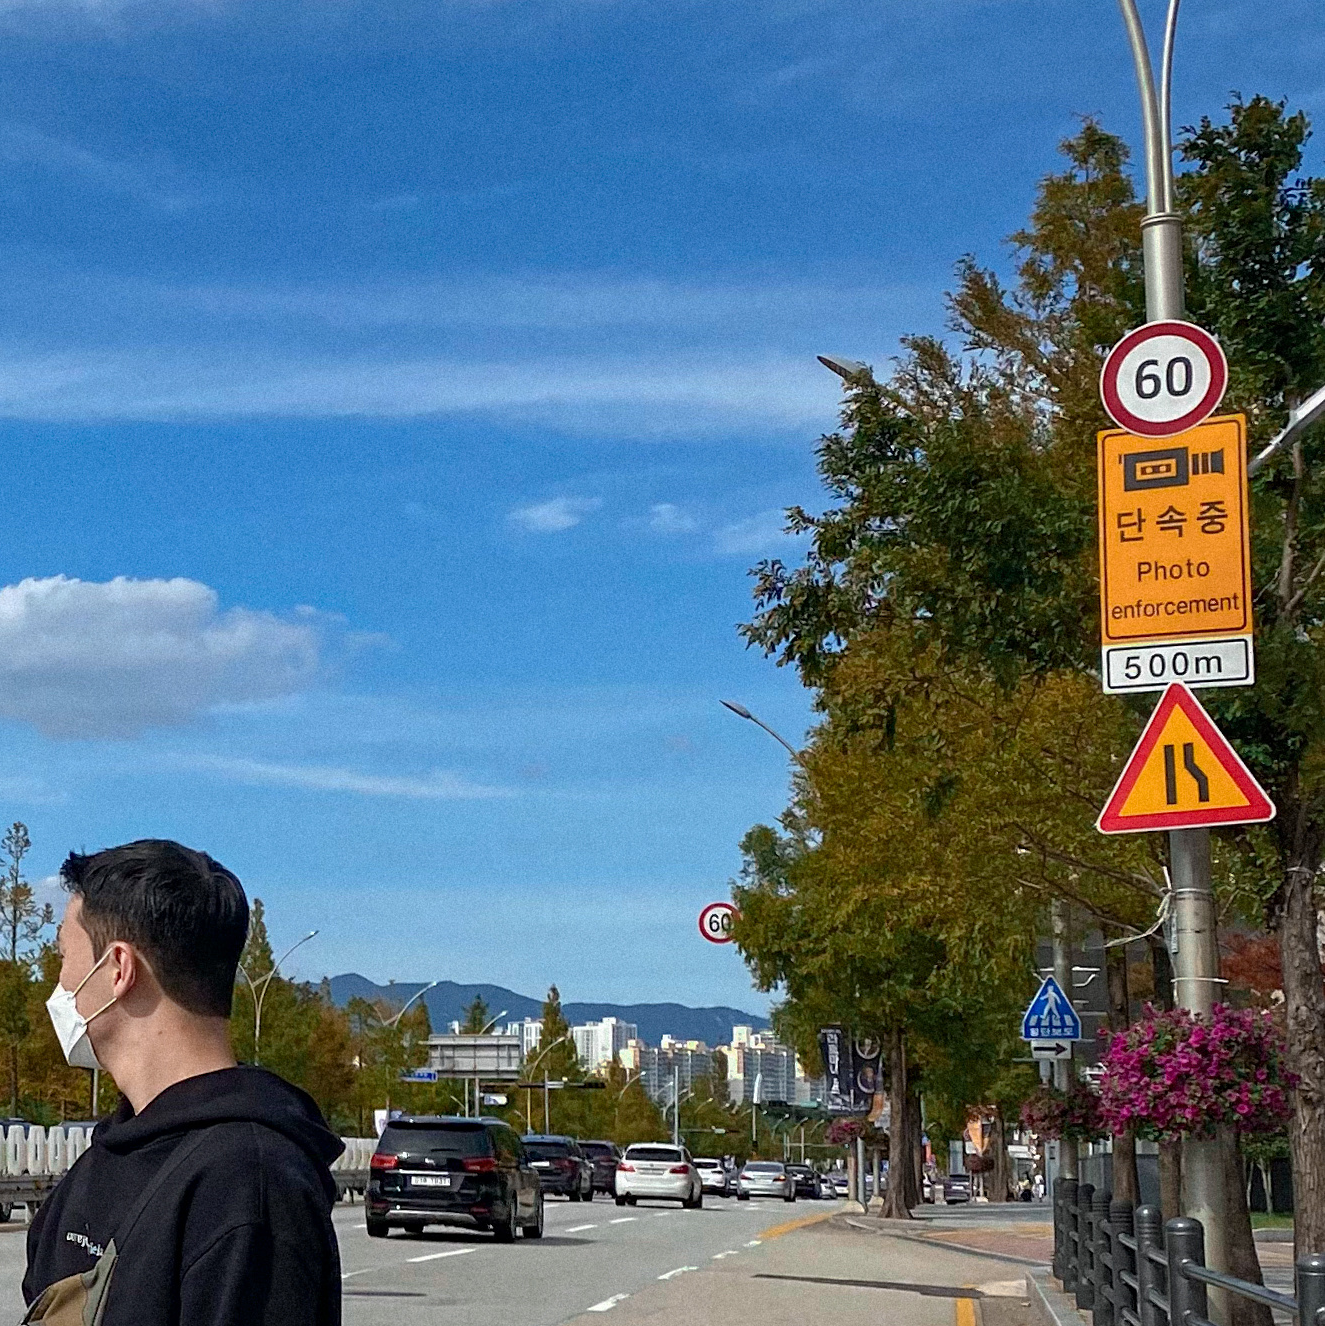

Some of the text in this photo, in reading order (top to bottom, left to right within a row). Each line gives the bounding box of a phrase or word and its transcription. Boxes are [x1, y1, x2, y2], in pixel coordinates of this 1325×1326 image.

[1135, 356, 1193, 399] 60
[1117, 500, 1228, 543] 단속중
[1137, 558, 1210, 582] Photo
[1111, 592, 1240, 620] enforcement
[1124, 651, 1222, 680] 500m
[709, 913, 731, 932] 60
